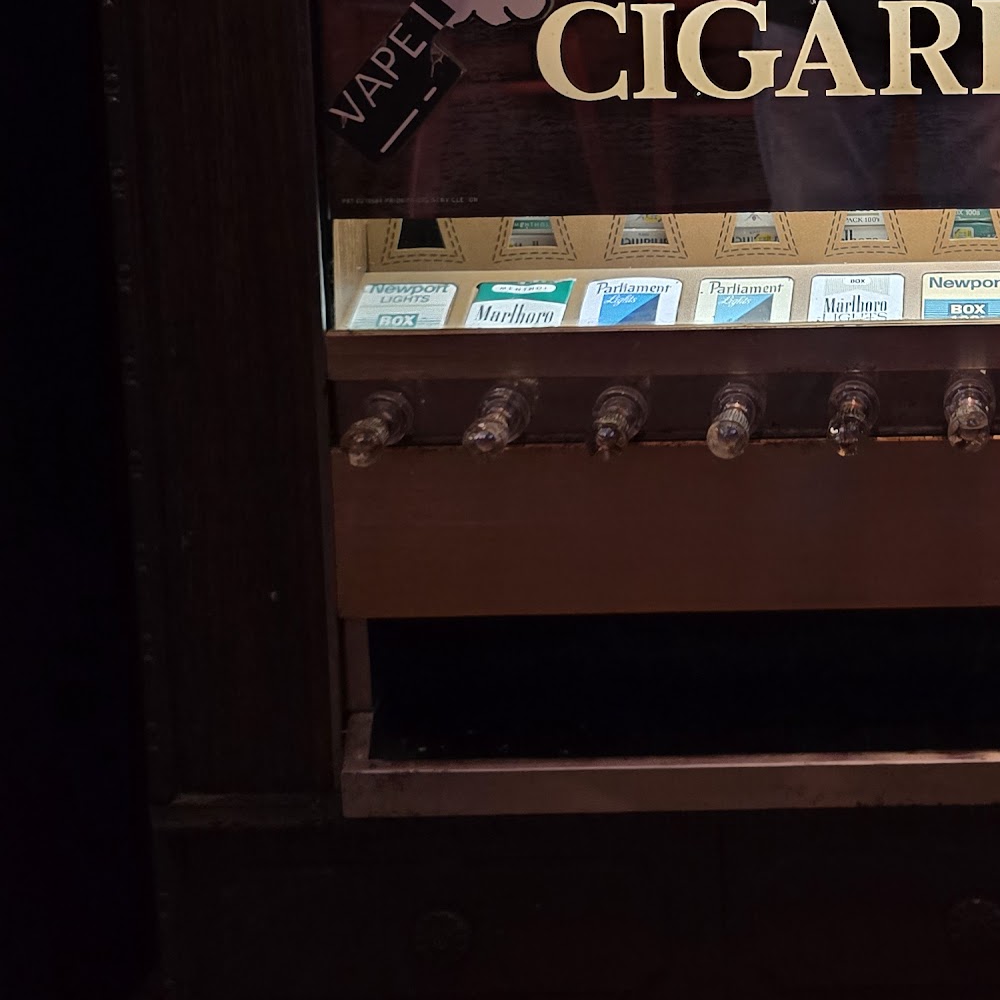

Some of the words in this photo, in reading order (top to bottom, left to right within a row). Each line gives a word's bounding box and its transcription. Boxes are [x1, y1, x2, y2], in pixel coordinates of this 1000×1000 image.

[328, 23, 427, 123] VAPE
[366, 284, 449, 296] Newport
[596, 282, 672, 296] Parliament
[710, 281, 784, 295] Parliament
[380, 295, 430, 304] LIGHTS
[824, 294, 888, 314] Marlboro
[475, 303, 555, 325] Marlboro
[950, 303, 986, 315] BOX
[380, 314, 416, 328] BOX
